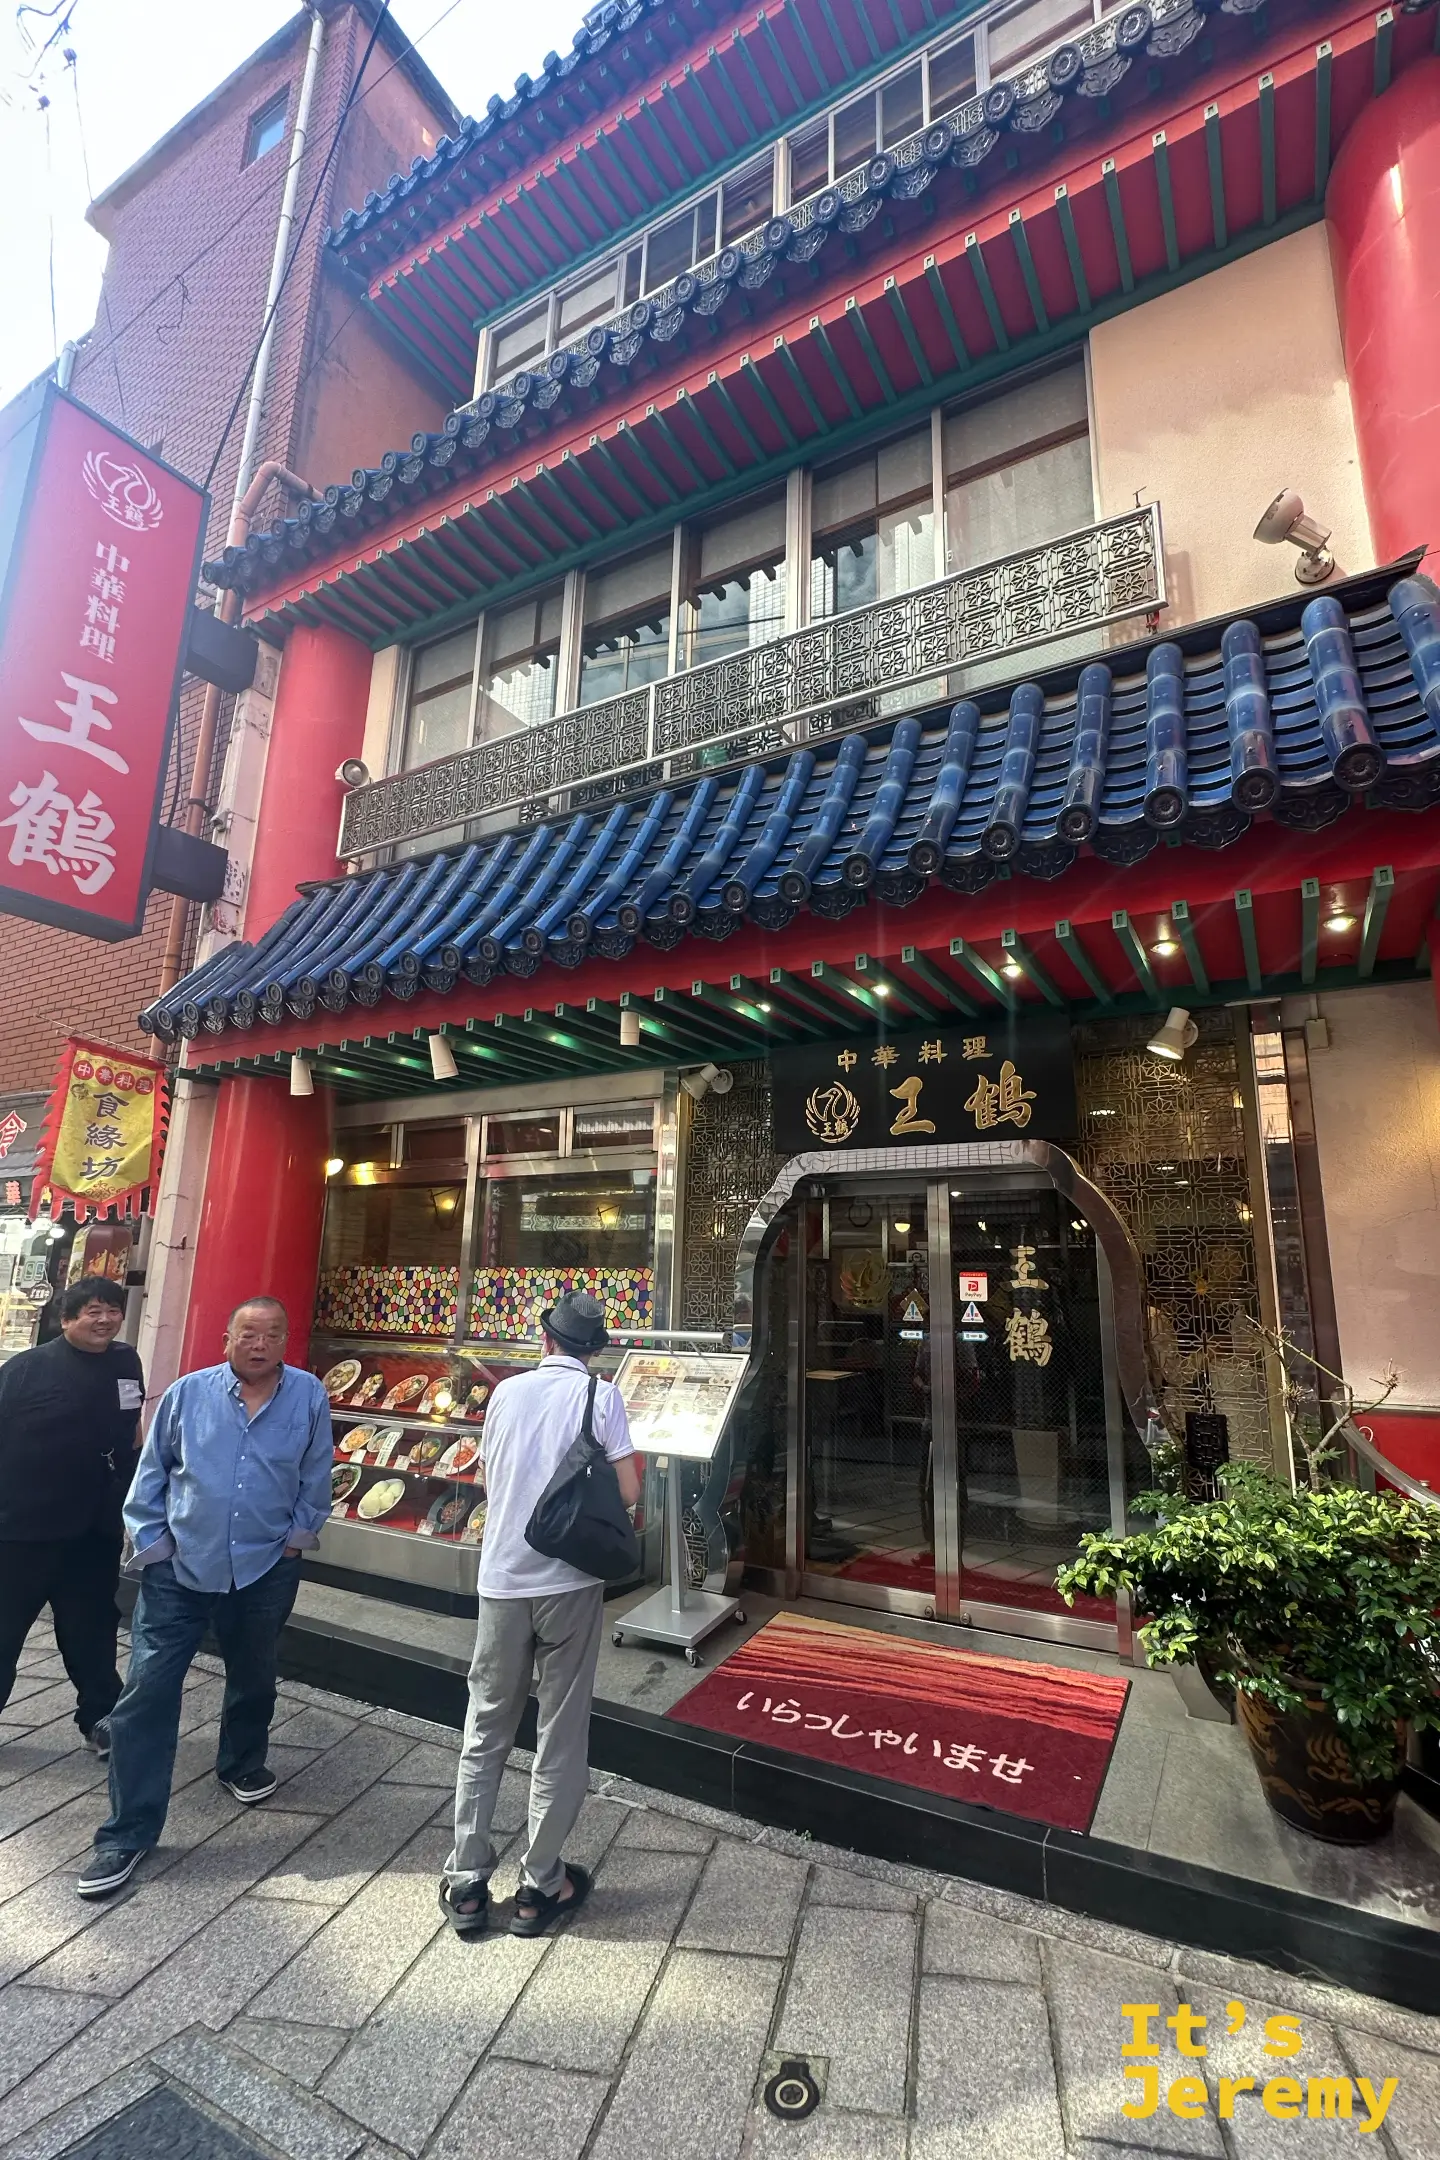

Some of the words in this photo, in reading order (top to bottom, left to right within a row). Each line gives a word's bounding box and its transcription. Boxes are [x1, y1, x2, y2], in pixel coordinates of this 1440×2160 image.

[80, 541, 130, 664] 中華料理
[0, 671, 130, 896] 王鶴
[77, 1063, 151, 1093] 中華料理
[837, 1035, 993, 1073] 中華料理
[889, 1060, 1037, 1136] 王鶴
[1001, 1245, 1053, 1367] 王鶴
[736, 1692, 1035, 1784] いらっしゃいませ
